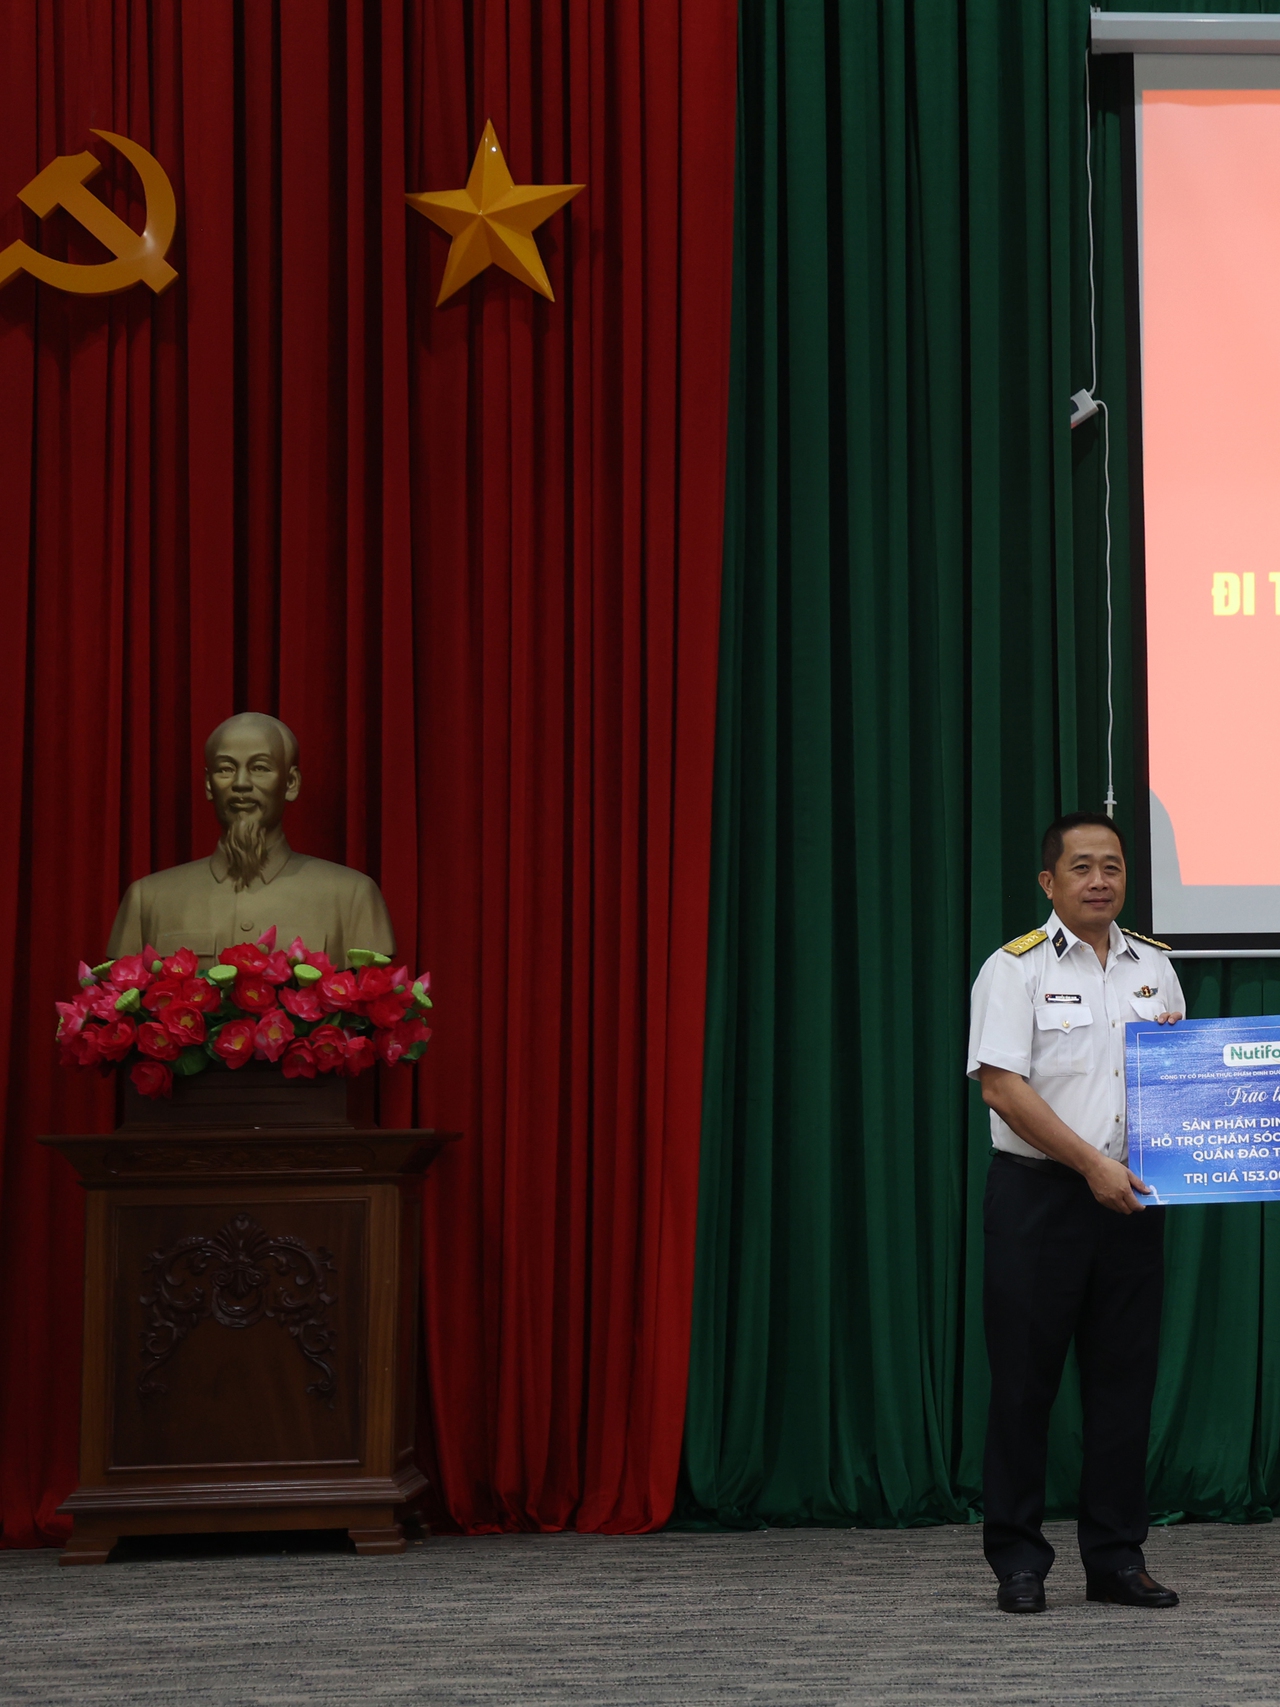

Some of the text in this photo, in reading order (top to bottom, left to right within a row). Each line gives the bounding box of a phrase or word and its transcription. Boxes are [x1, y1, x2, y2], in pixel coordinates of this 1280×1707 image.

[1211, 572, 1255, 616] ĐI
[1225, 1084, 1268, 1107] Trao
[1182, 1118, 1210, 1131] SẢN
[1215, 1116, 1256, 1129] PHẨM
[1151, 1133, 1172, 1147] HỖ
[1176, 1134, 1204, 1147] TRỢ
[1208, 1132, 1250, 1144] CHĂM
[1237, 1145, 1269, 1159] ĐẢO
[1183, 1172, 1208, 1186] TRỊ
[1212, 1169, 1239, 1183] GIÁ
